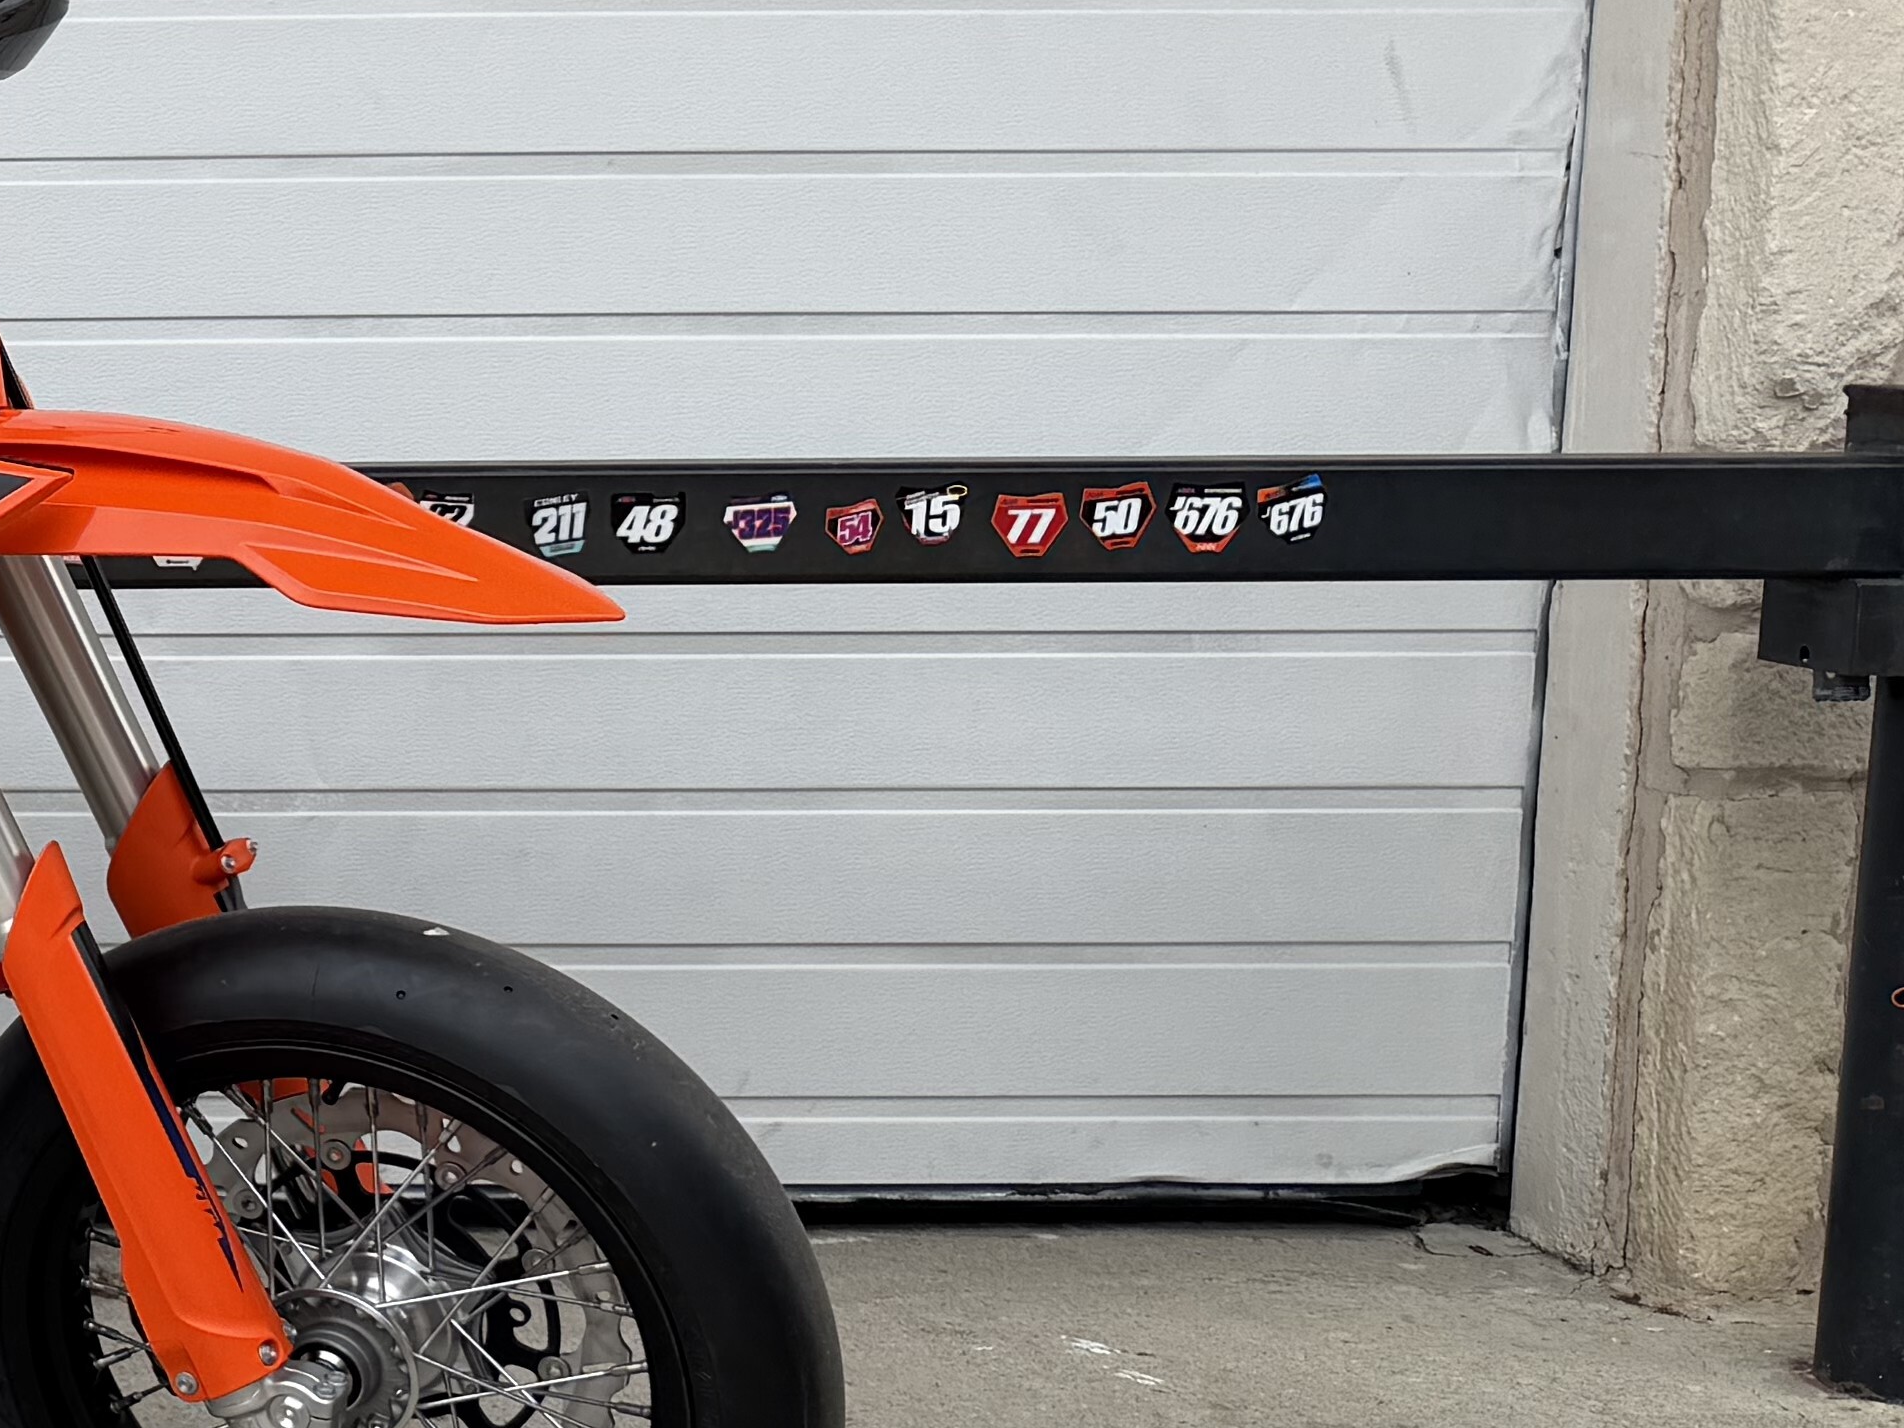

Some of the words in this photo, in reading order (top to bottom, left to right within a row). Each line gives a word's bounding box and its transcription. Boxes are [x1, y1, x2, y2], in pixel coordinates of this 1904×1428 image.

[531, 502, 587, 545] 211
[616, 504, 678, 544] 48
[837, 511, 873, 545] 54
[904, 494, 961, 537] 15
[1006, 508, 1056, 544] 77
[1092, 497, 1142, 538] 50
